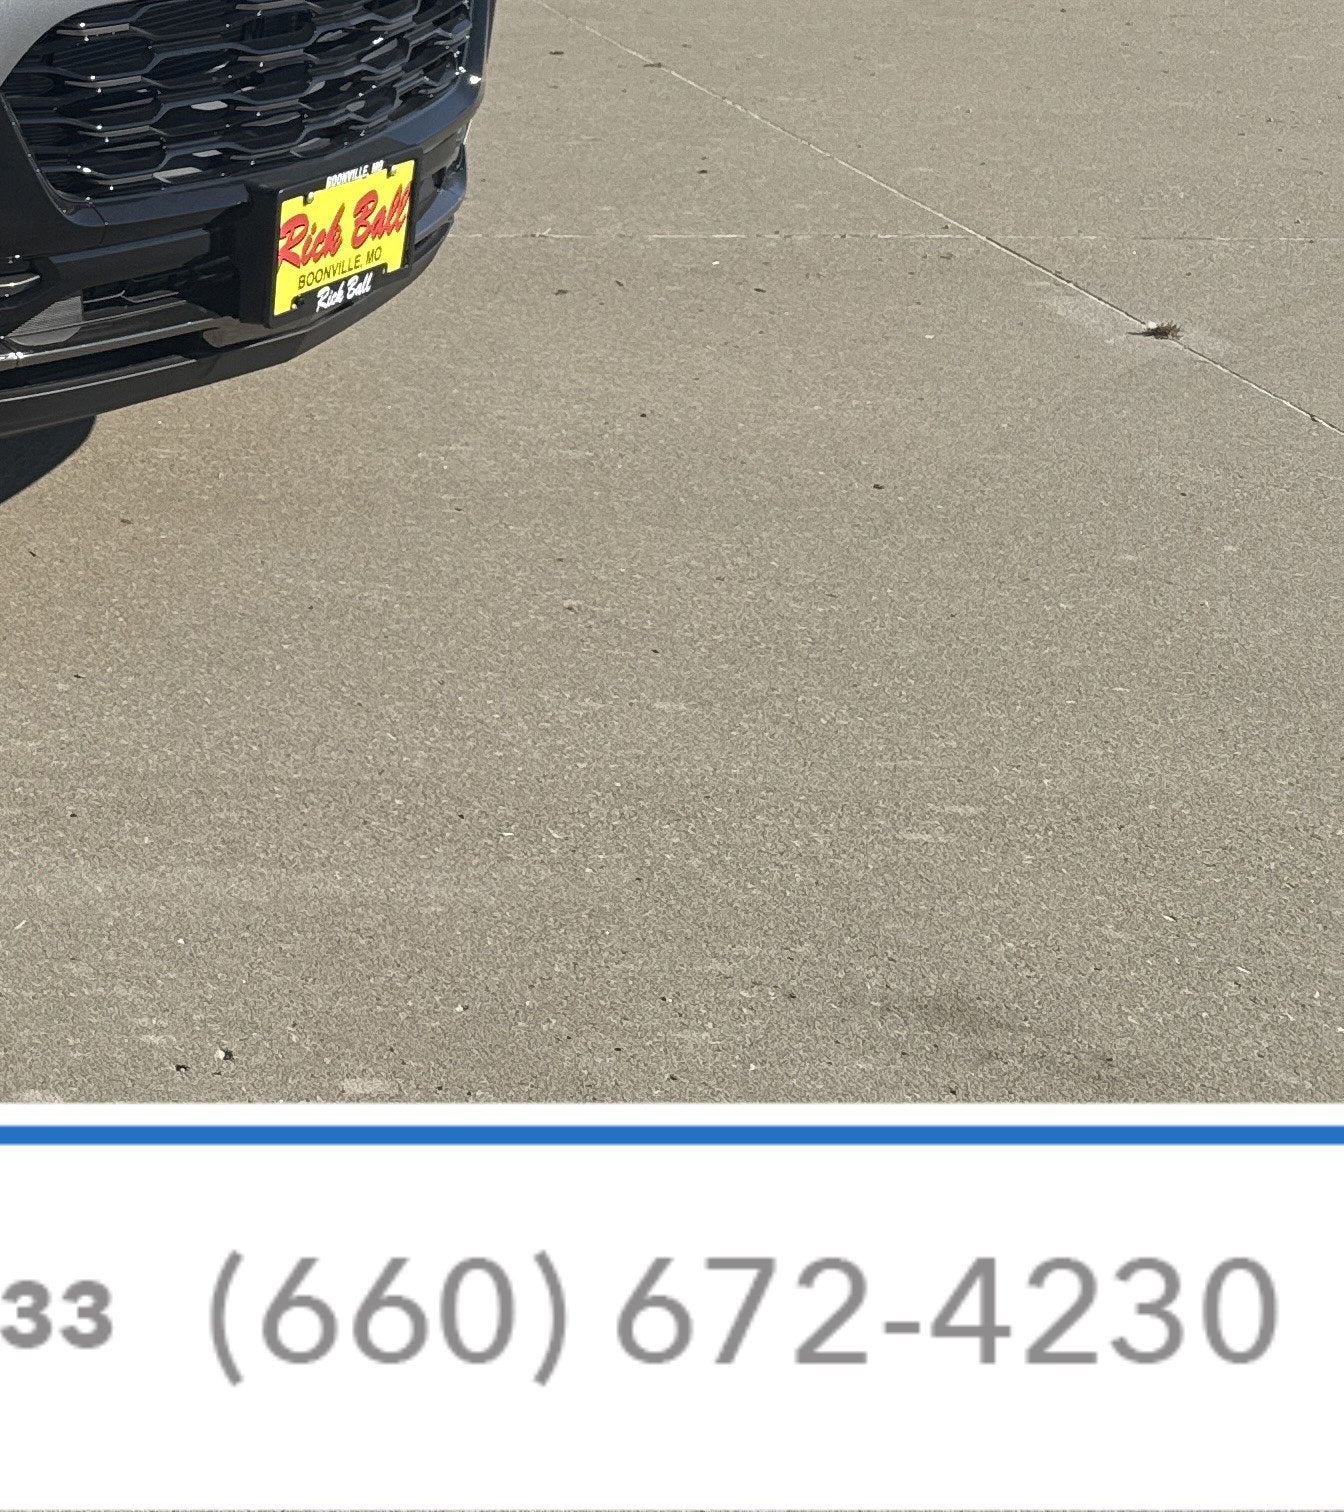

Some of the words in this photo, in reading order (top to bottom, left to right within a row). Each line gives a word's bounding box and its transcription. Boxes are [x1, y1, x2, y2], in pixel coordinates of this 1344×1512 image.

[278, 202, 346, 268] Rick
[350, 183, 412, 249] Ball
[365, 245, 382, 264] MO
[315, 280, 346, 313] Rick
[346, 271, 373, 300] Ball
